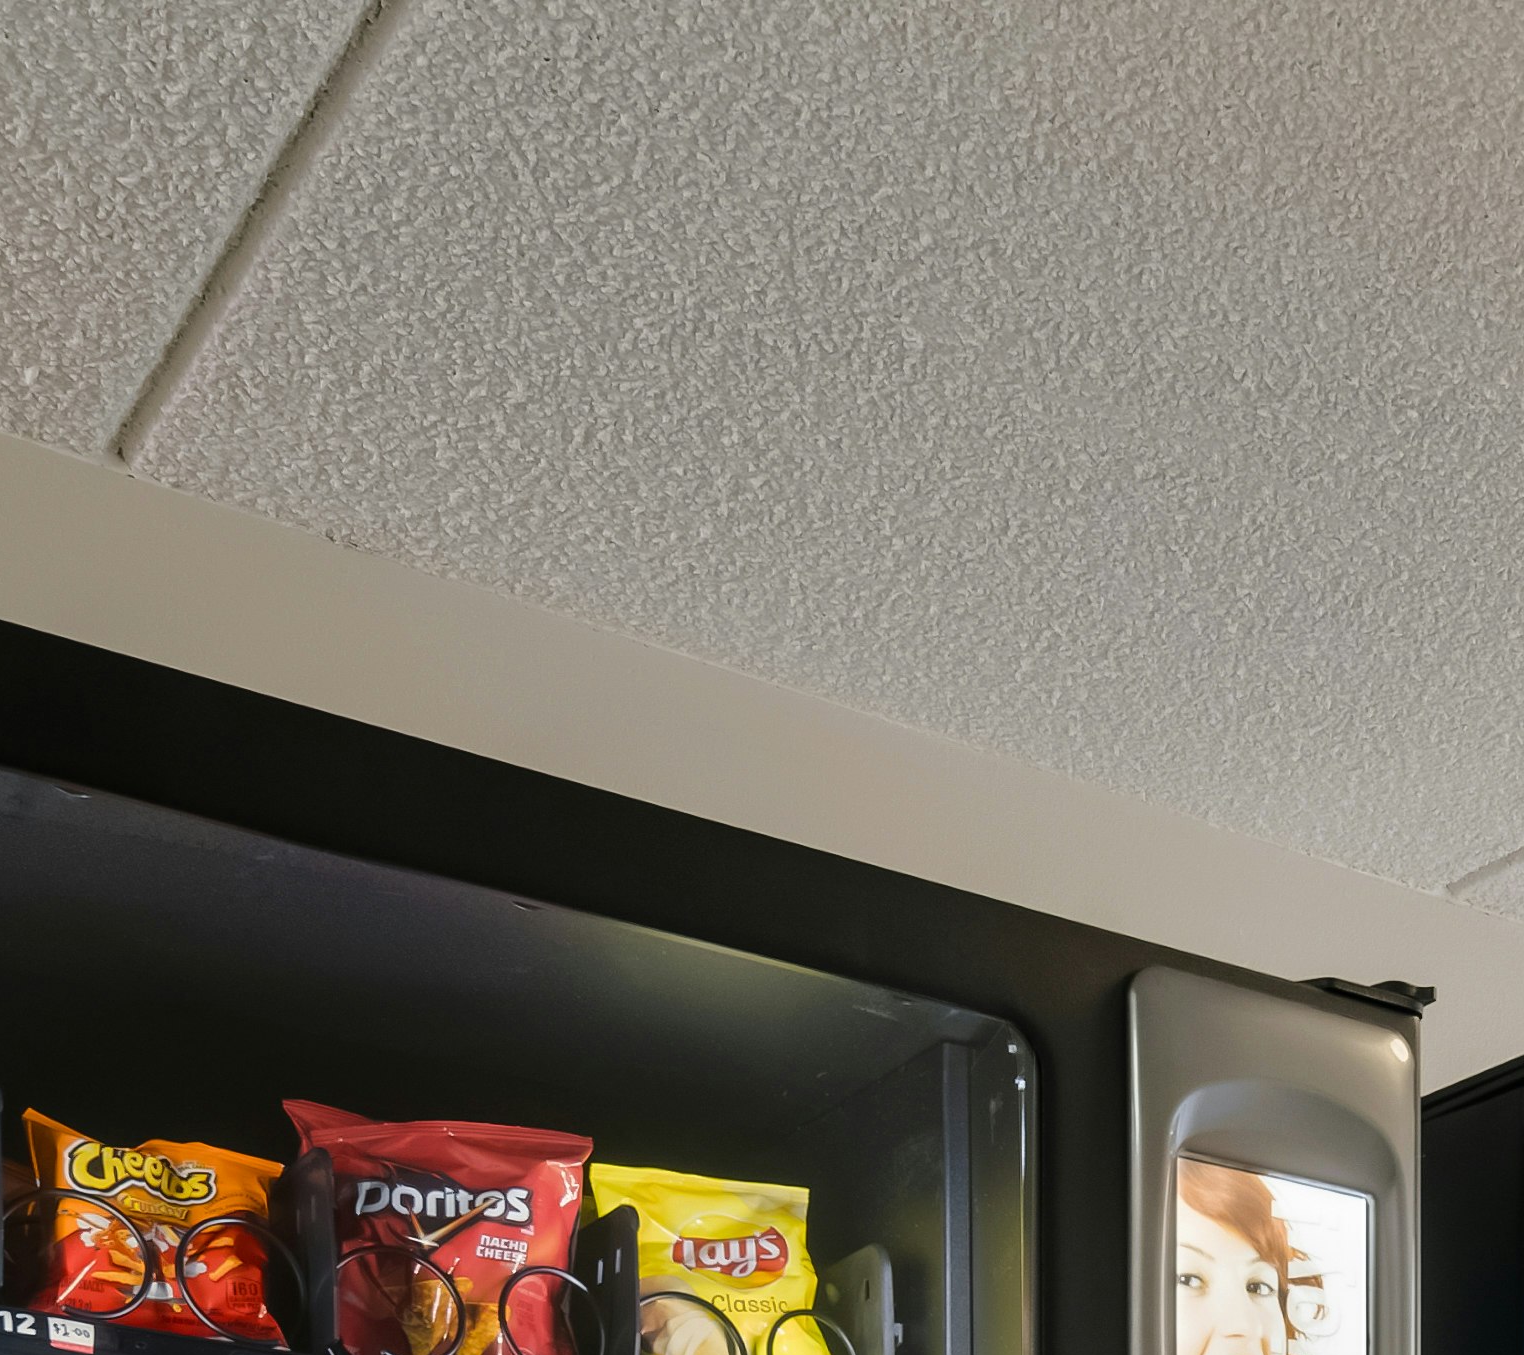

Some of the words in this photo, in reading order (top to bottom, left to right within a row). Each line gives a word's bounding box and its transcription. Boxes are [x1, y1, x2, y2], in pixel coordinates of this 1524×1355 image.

[355, 1180, 531, 1223] Doritos
[480, 1234, 528, 1252] NACHO
[476, 1246, 527, 1264] CHEESE
[711, 1294, 790, 1314] Classic
